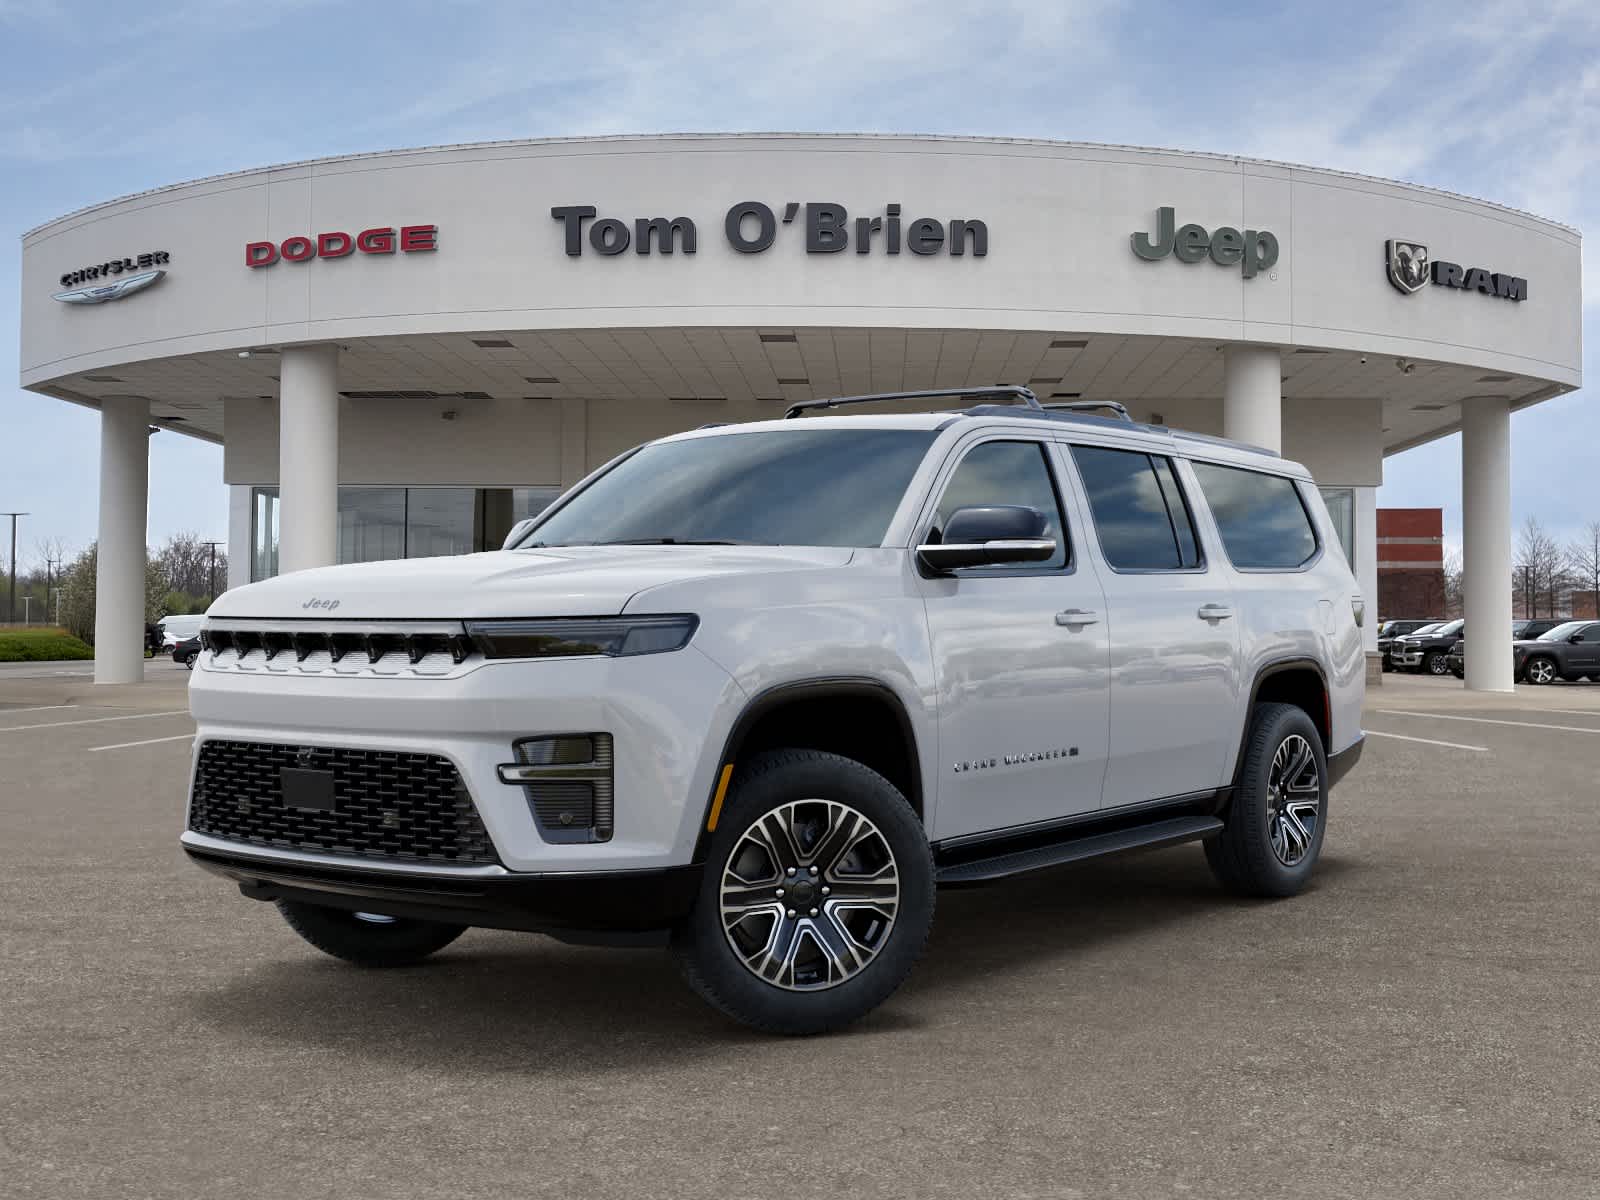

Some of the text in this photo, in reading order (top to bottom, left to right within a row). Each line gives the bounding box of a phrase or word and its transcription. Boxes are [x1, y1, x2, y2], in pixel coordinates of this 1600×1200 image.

[245, 224, 438, 269] DODGE
[551, 201, 988, 256] Tom O'Brien
[1130, 207, 1279, 278] Jeep
[60, 250, 170, 287] CHRYSLER
[1431, 261, 1528, 301] RAM
[302, 597, 340, 611] Jeep
